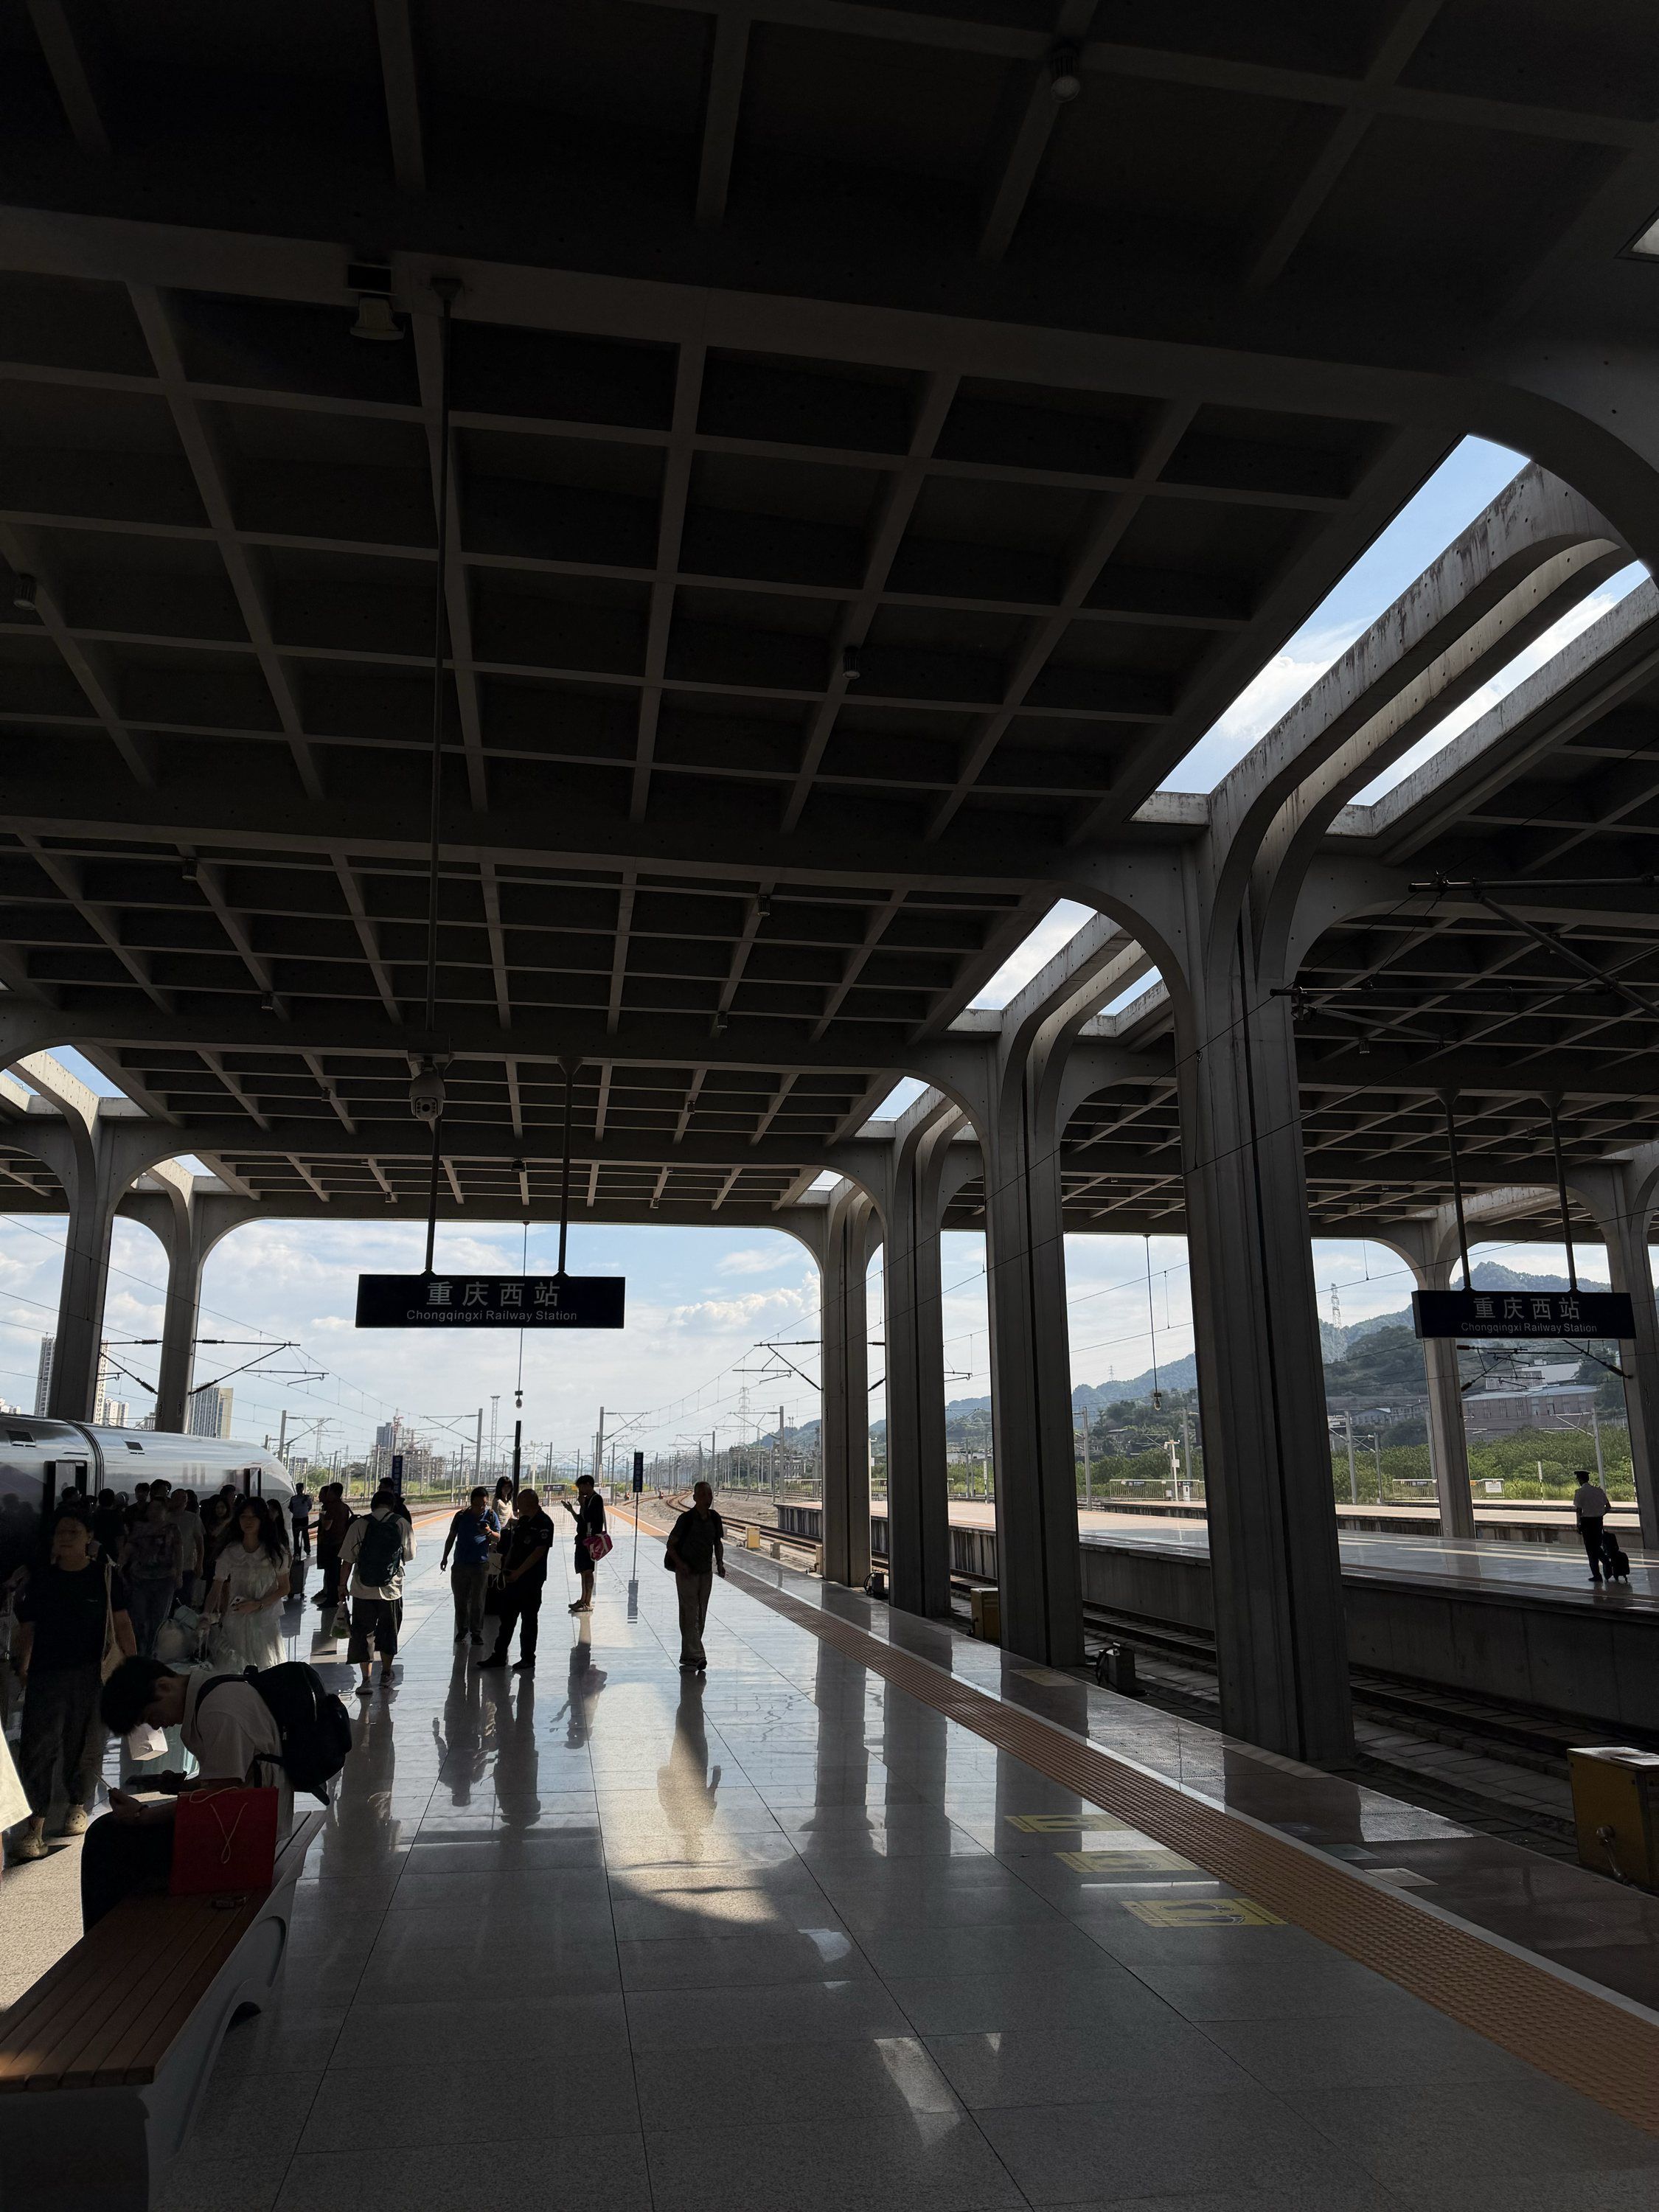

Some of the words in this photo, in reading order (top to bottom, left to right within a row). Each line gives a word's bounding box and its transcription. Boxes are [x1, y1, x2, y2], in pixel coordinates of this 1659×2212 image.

[426, 1281, 560, 1307] 重庆西站
[406, 1310, 483, 1322] Chongqingxi
[486, 1310, 532, 1322] Railway
[536, 1311, 577, 1321] Station
[1473, 1296, 1580, 1320] 重庆西站
[1461, 1322, 1522, 1333] Chongqingxi
[1524, 1324, 1562, 1333] Railway
[1564, 1324, 1597, 1332] Station
